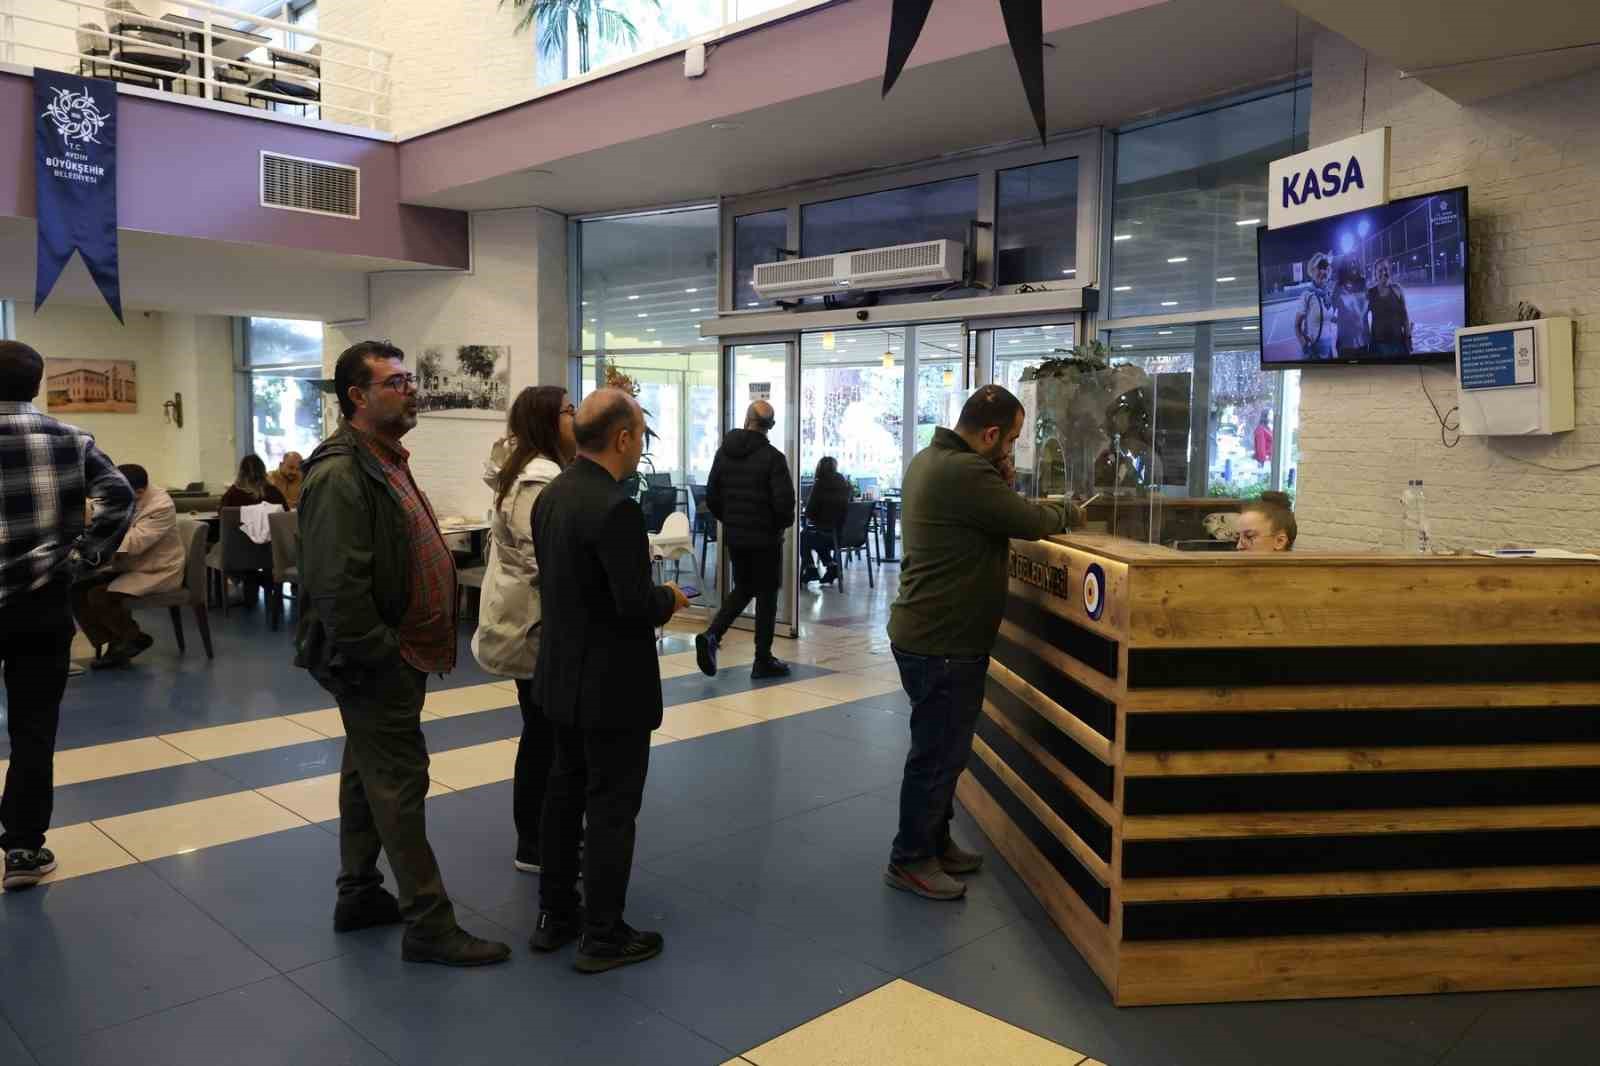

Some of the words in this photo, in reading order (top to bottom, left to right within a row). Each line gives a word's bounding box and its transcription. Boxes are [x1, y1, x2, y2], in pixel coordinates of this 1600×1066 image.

[65, 151, 88, 161] AYDIN
[46, 157, 104, 176] BÜYÜKŞEHİR
[54, 169, 97, 184] BELEDİYESİ
[1282, 155, 1365, 208] KASA
